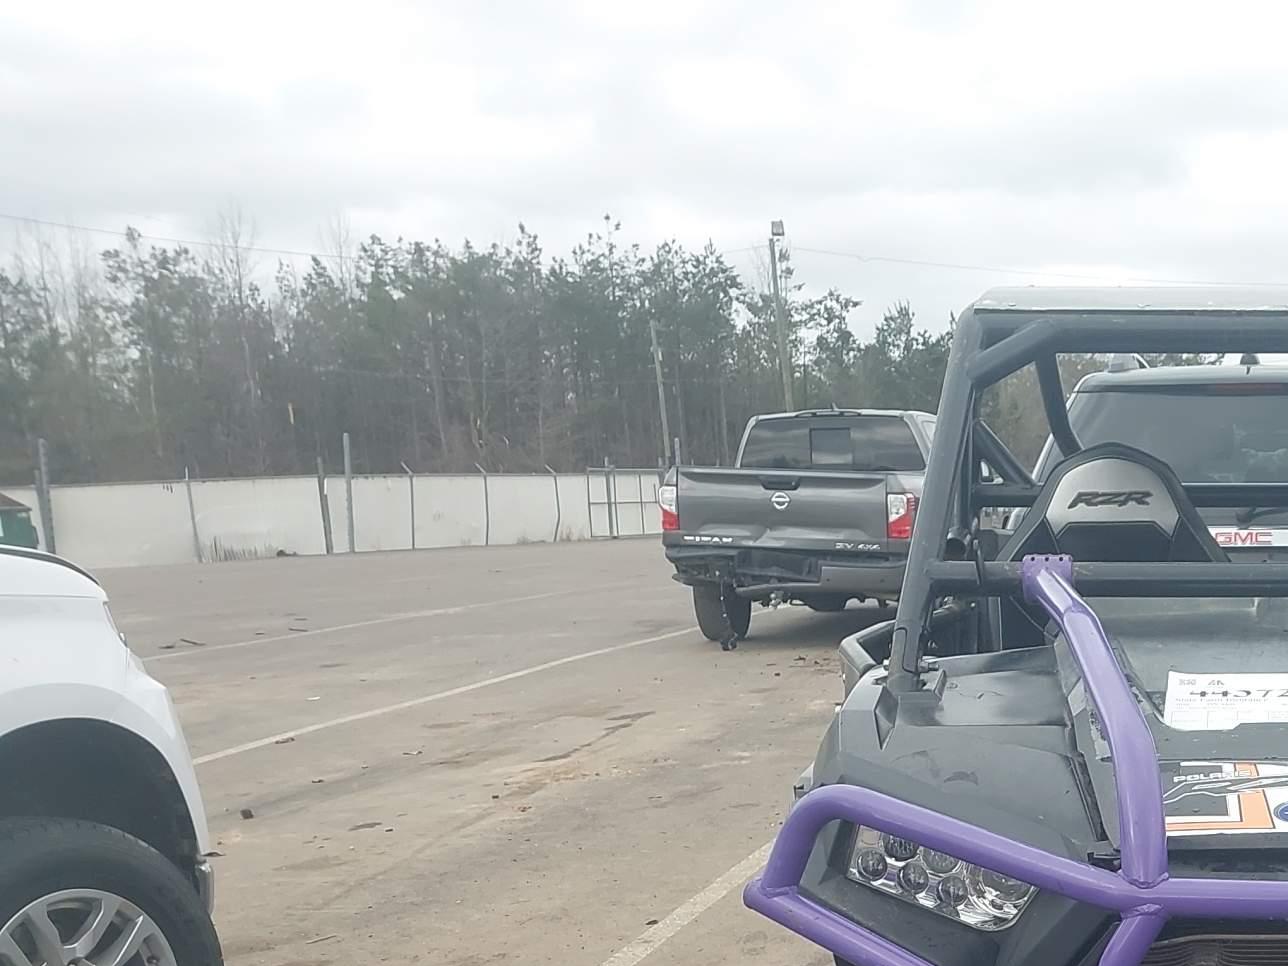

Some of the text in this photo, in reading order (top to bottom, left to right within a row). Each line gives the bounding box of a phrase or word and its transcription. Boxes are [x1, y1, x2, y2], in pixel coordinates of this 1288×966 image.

[1067, 490, 1154, 510] RZR
[1215, 532, 1274, 545] GMC
[1173, 769, 1254, 783] POLARIS
